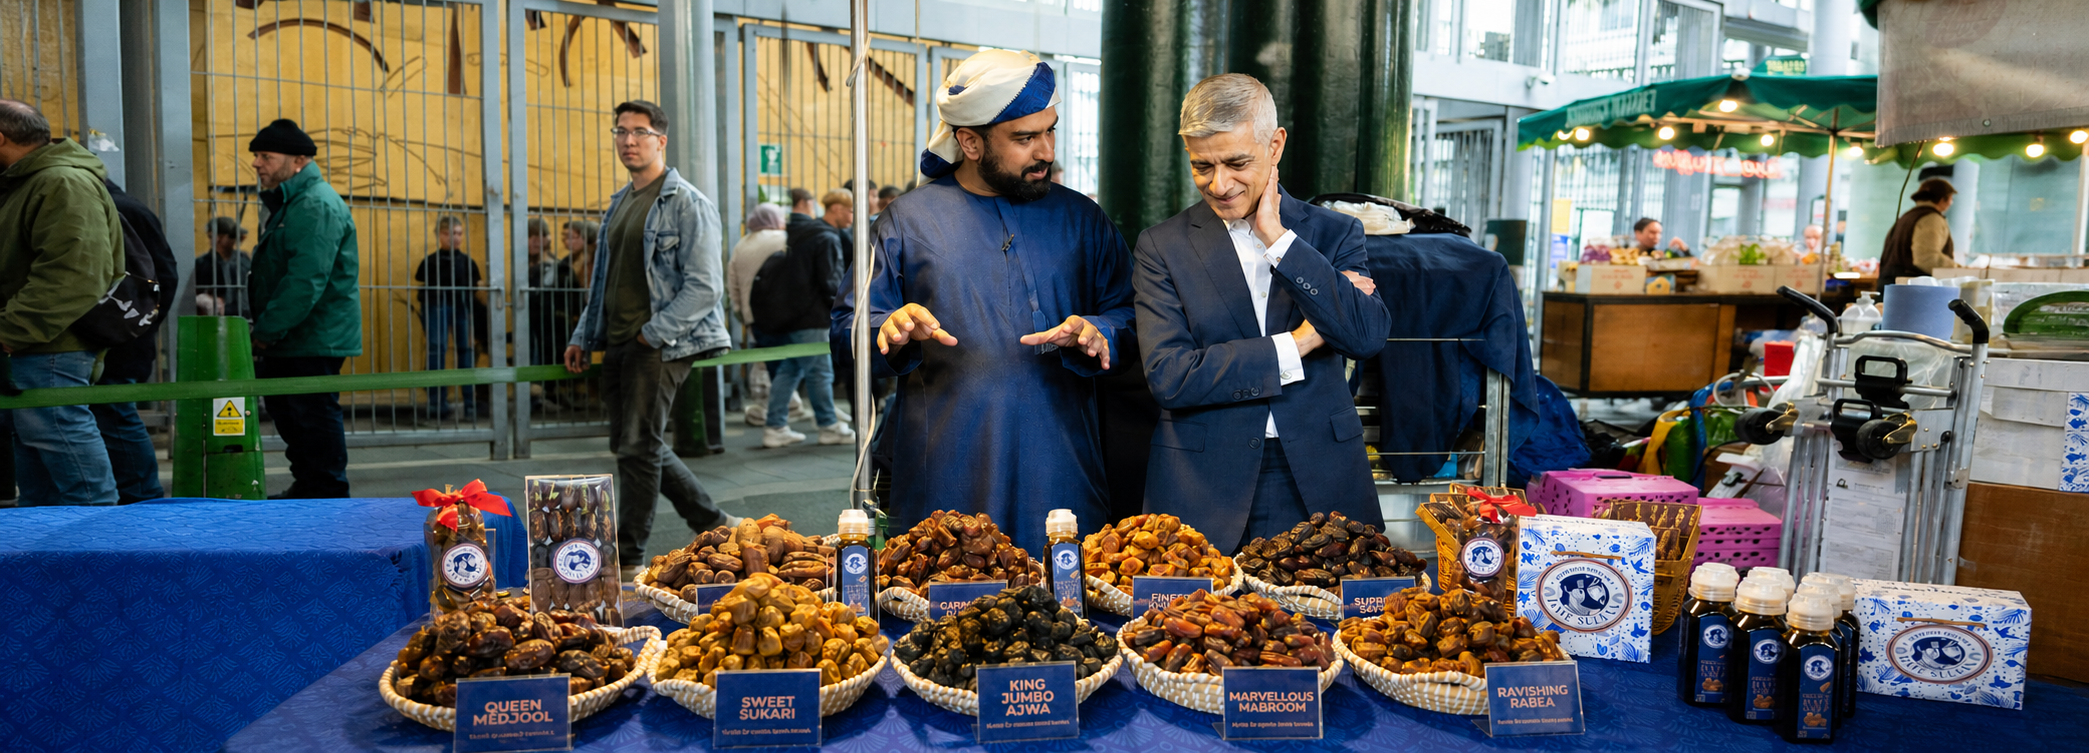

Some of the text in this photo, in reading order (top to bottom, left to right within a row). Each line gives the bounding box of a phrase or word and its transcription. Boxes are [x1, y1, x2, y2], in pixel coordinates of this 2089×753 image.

[1009, 678, 1046, 691] KING
[1001, 690, 1054, 704] JUMBO
[1229, 691, 1314, 701] MARVELLOUS
[1497, 685, 1568, 697] RAVISHING
[484, 699, 542, 713] QUEEN
[741, 696, 795, 708] SWEET
[1238, 702, 1306, 712] MABROOM
[1510, 697, 1556, 708] RABEA
[739, 708, 795, 720] SUKARI
[1005, 703, 1051, 716] AJWA
[473, 711, 553, 726] MEDJOOL
